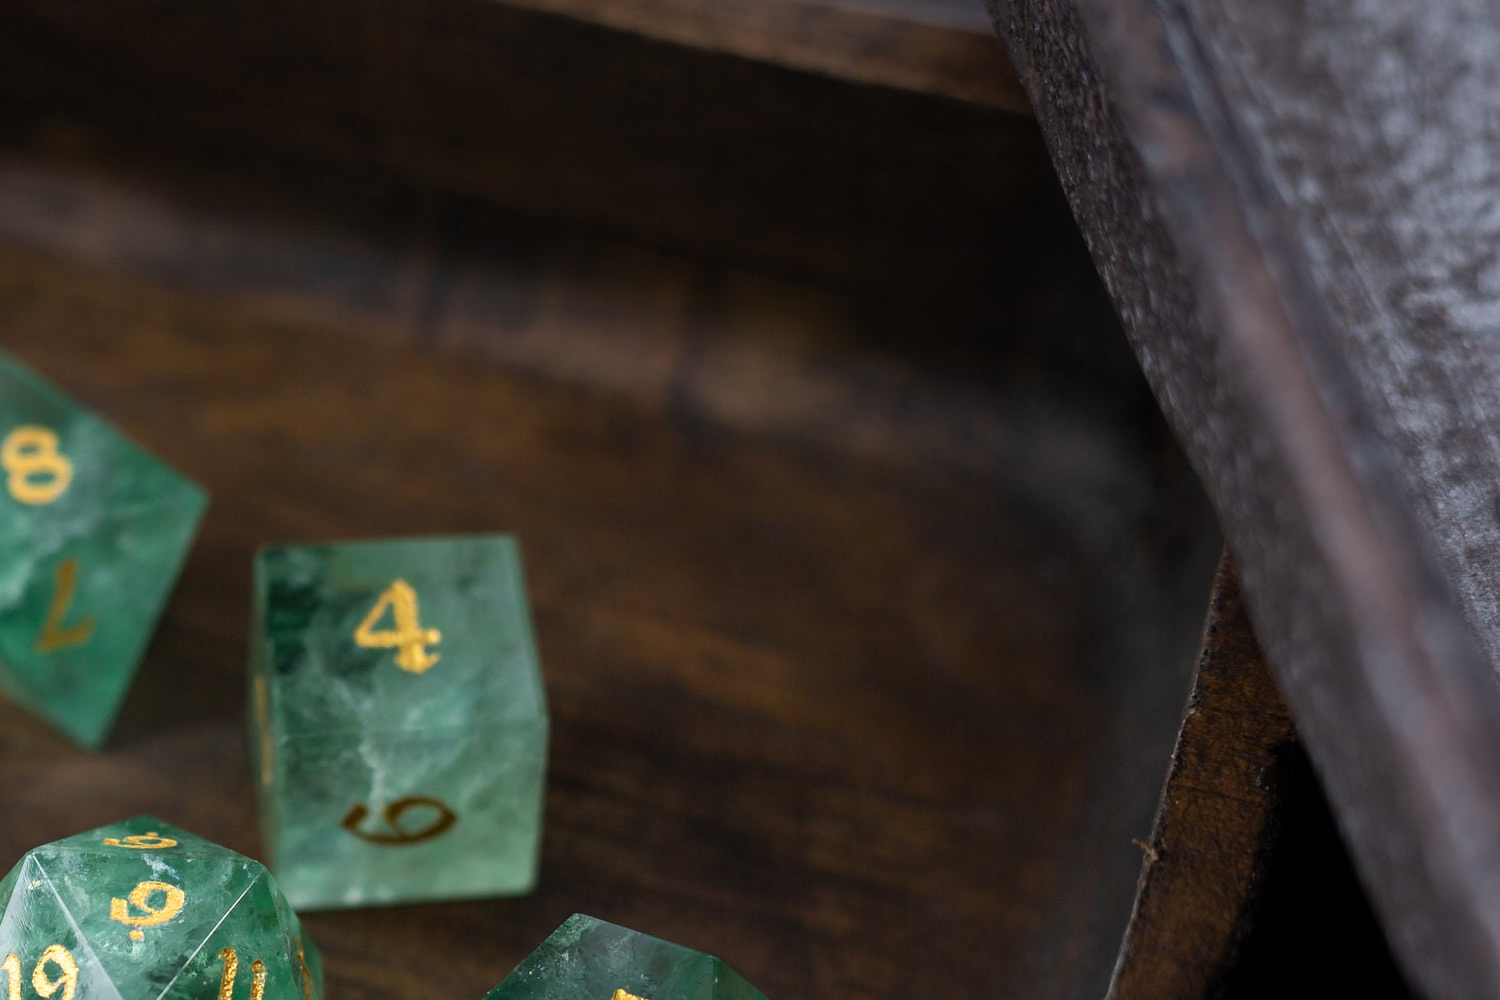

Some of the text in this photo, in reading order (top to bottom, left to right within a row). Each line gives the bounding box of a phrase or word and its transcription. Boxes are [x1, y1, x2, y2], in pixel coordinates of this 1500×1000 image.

[0, 424, 73, 504] 8
[35, 558, 95, 653] 7
[354, 579, 441, 673] 4
